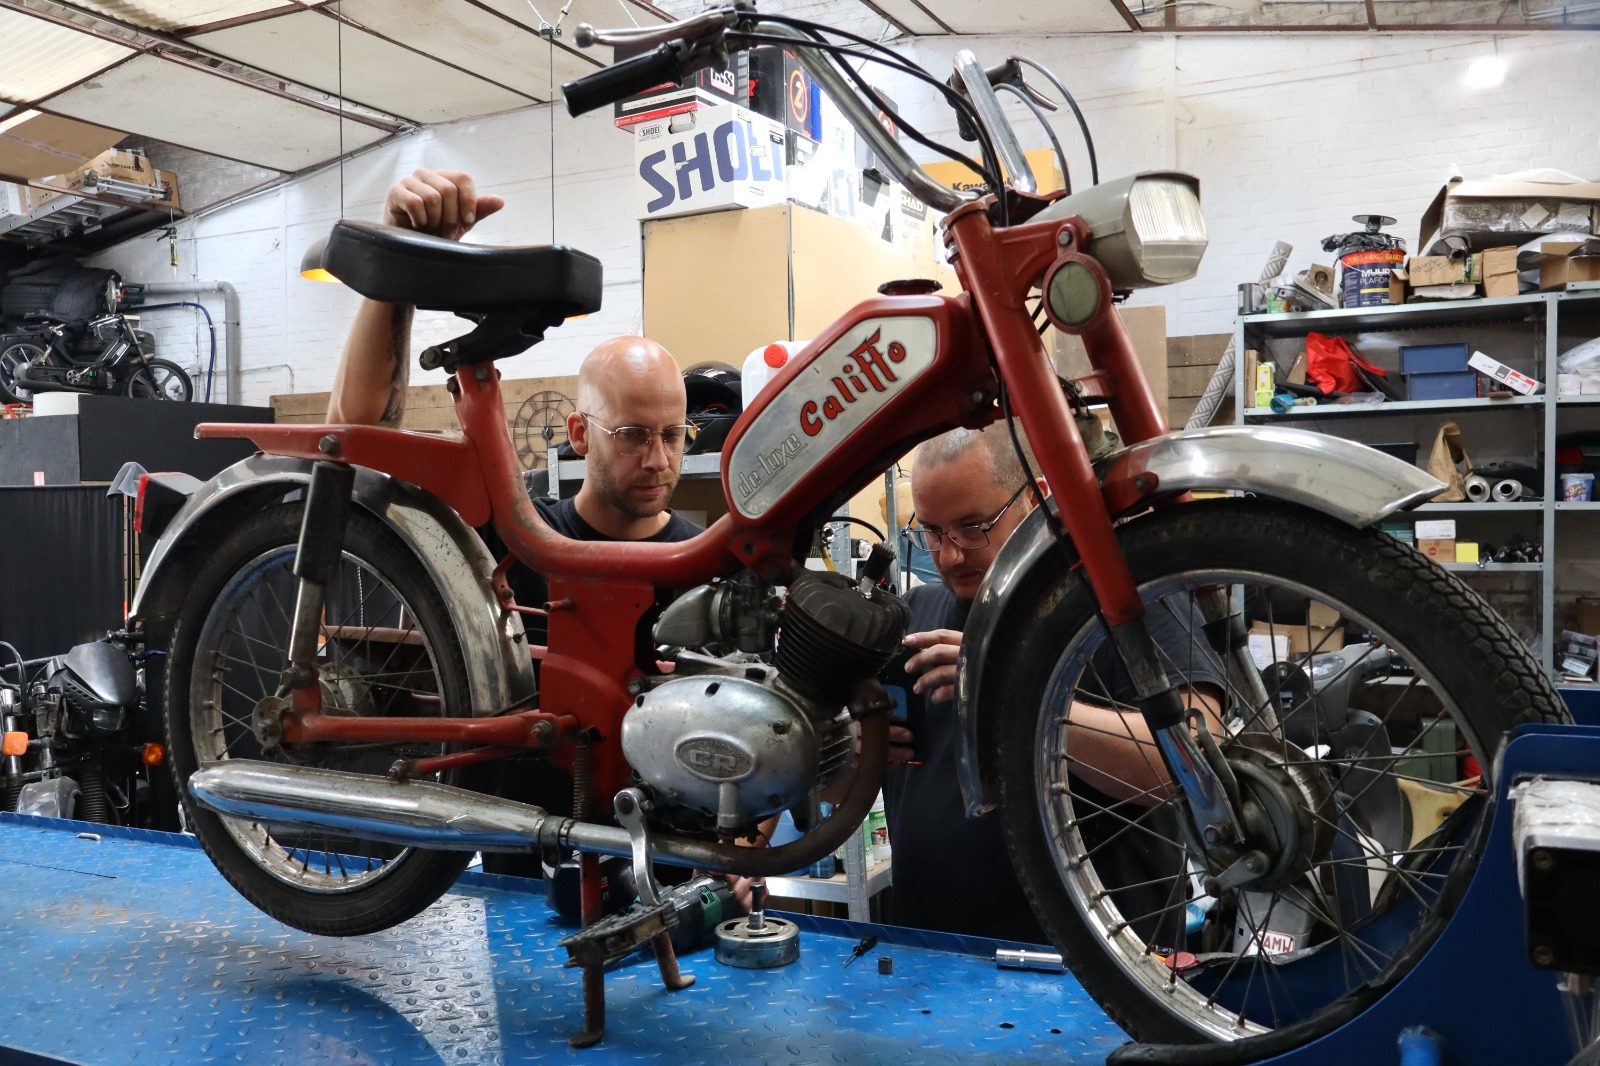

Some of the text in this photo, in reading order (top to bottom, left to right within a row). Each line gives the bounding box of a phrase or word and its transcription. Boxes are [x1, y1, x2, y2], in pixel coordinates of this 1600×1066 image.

[642, 125, 660, 137] SHOEI
[639, 119, 784, 213] SHOEI
[1360, 276, 1390, 286] PLAFON
[800, 325, 906, 437] Califfo
[738, 433, 803, 498] de luxe
